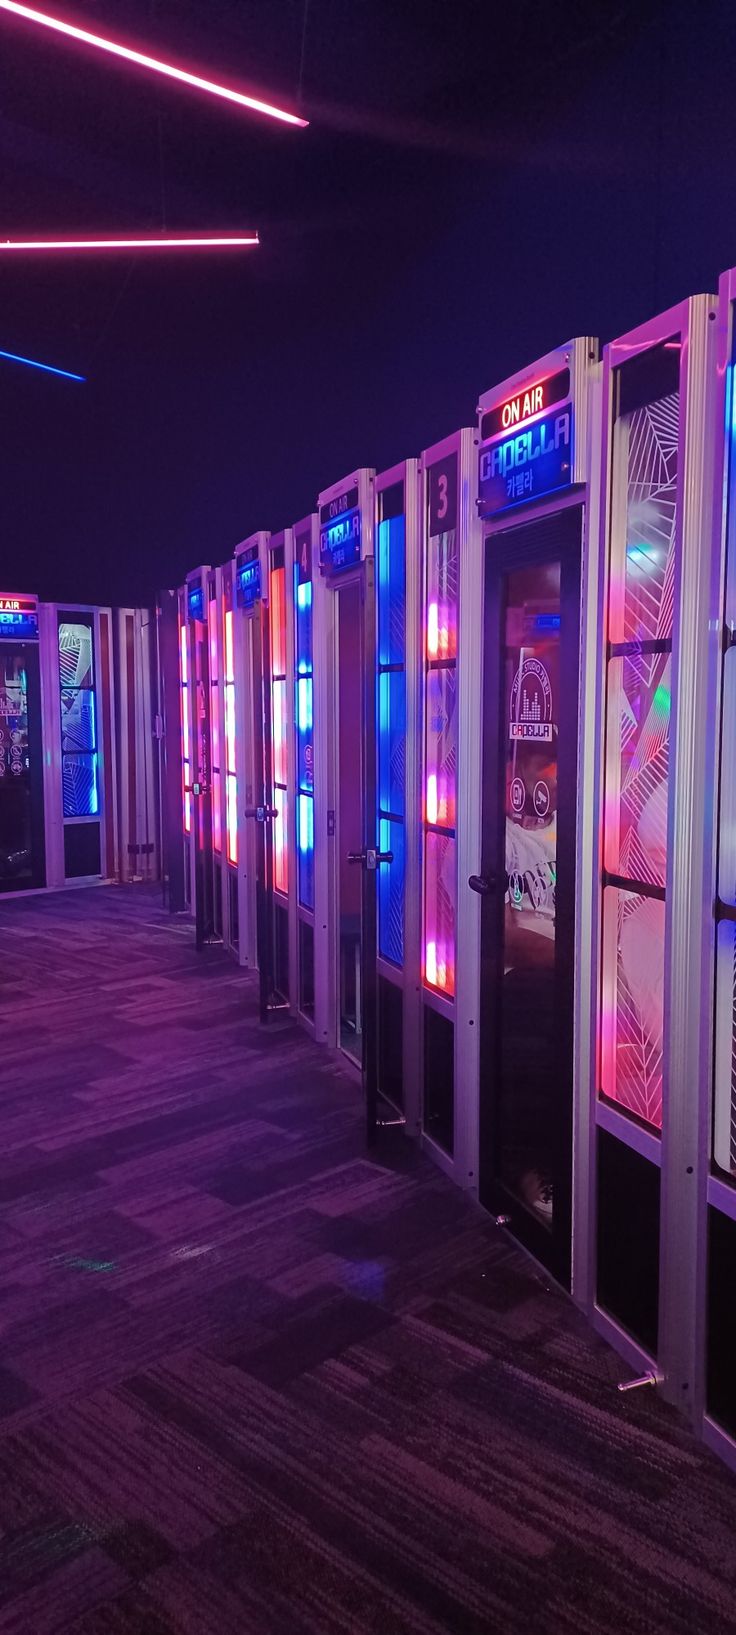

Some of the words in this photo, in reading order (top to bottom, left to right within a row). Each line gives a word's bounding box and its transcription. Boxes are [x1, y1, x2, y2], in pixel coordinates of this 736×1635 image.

[502, 398, 520, 427] ON
[522, 386, 544, 419] AIR
[480, 413, 570, 482] CAPELLA
[437, 474, 448, 519] 3
[507, 468, 533, 498] 카펠라
[329, 503, 338, 518] ON
[338, 495, 348, 511] AIR
[320, 516, 359, 552] CAPELLA
[301, 543, 308, 572] 4
[0, 613, 37, 625] ELLA
[5, 601, 20, 610] AIR
[512, 724, 549, 738] CAPELLA
